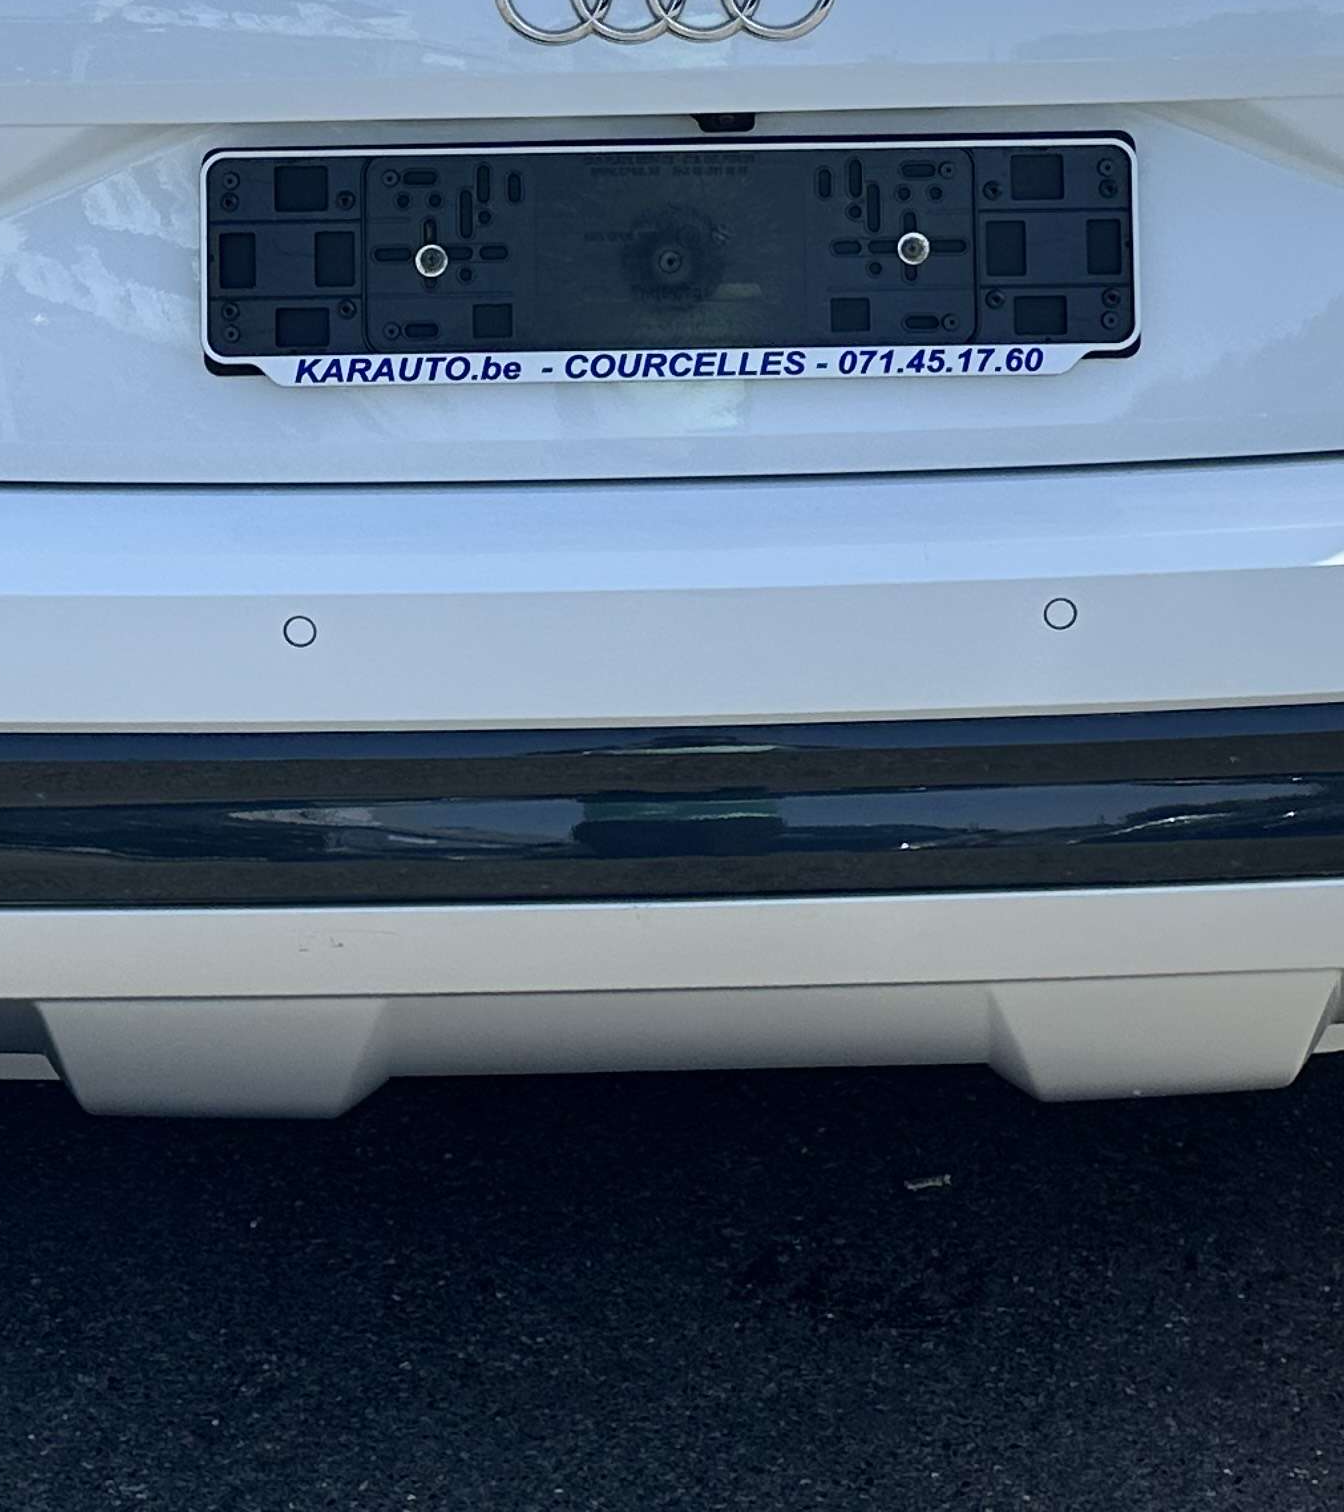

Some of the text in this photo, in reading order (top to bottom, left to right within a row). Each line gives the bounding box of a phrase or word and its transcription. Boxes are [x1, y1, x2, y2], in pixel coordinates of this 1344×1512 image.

[295, 355, 523, 384] KARAUTO.be
[564, 352, 806, 380] COURCELLES
[838, 348, 1044, 375] 071.45.17.60
